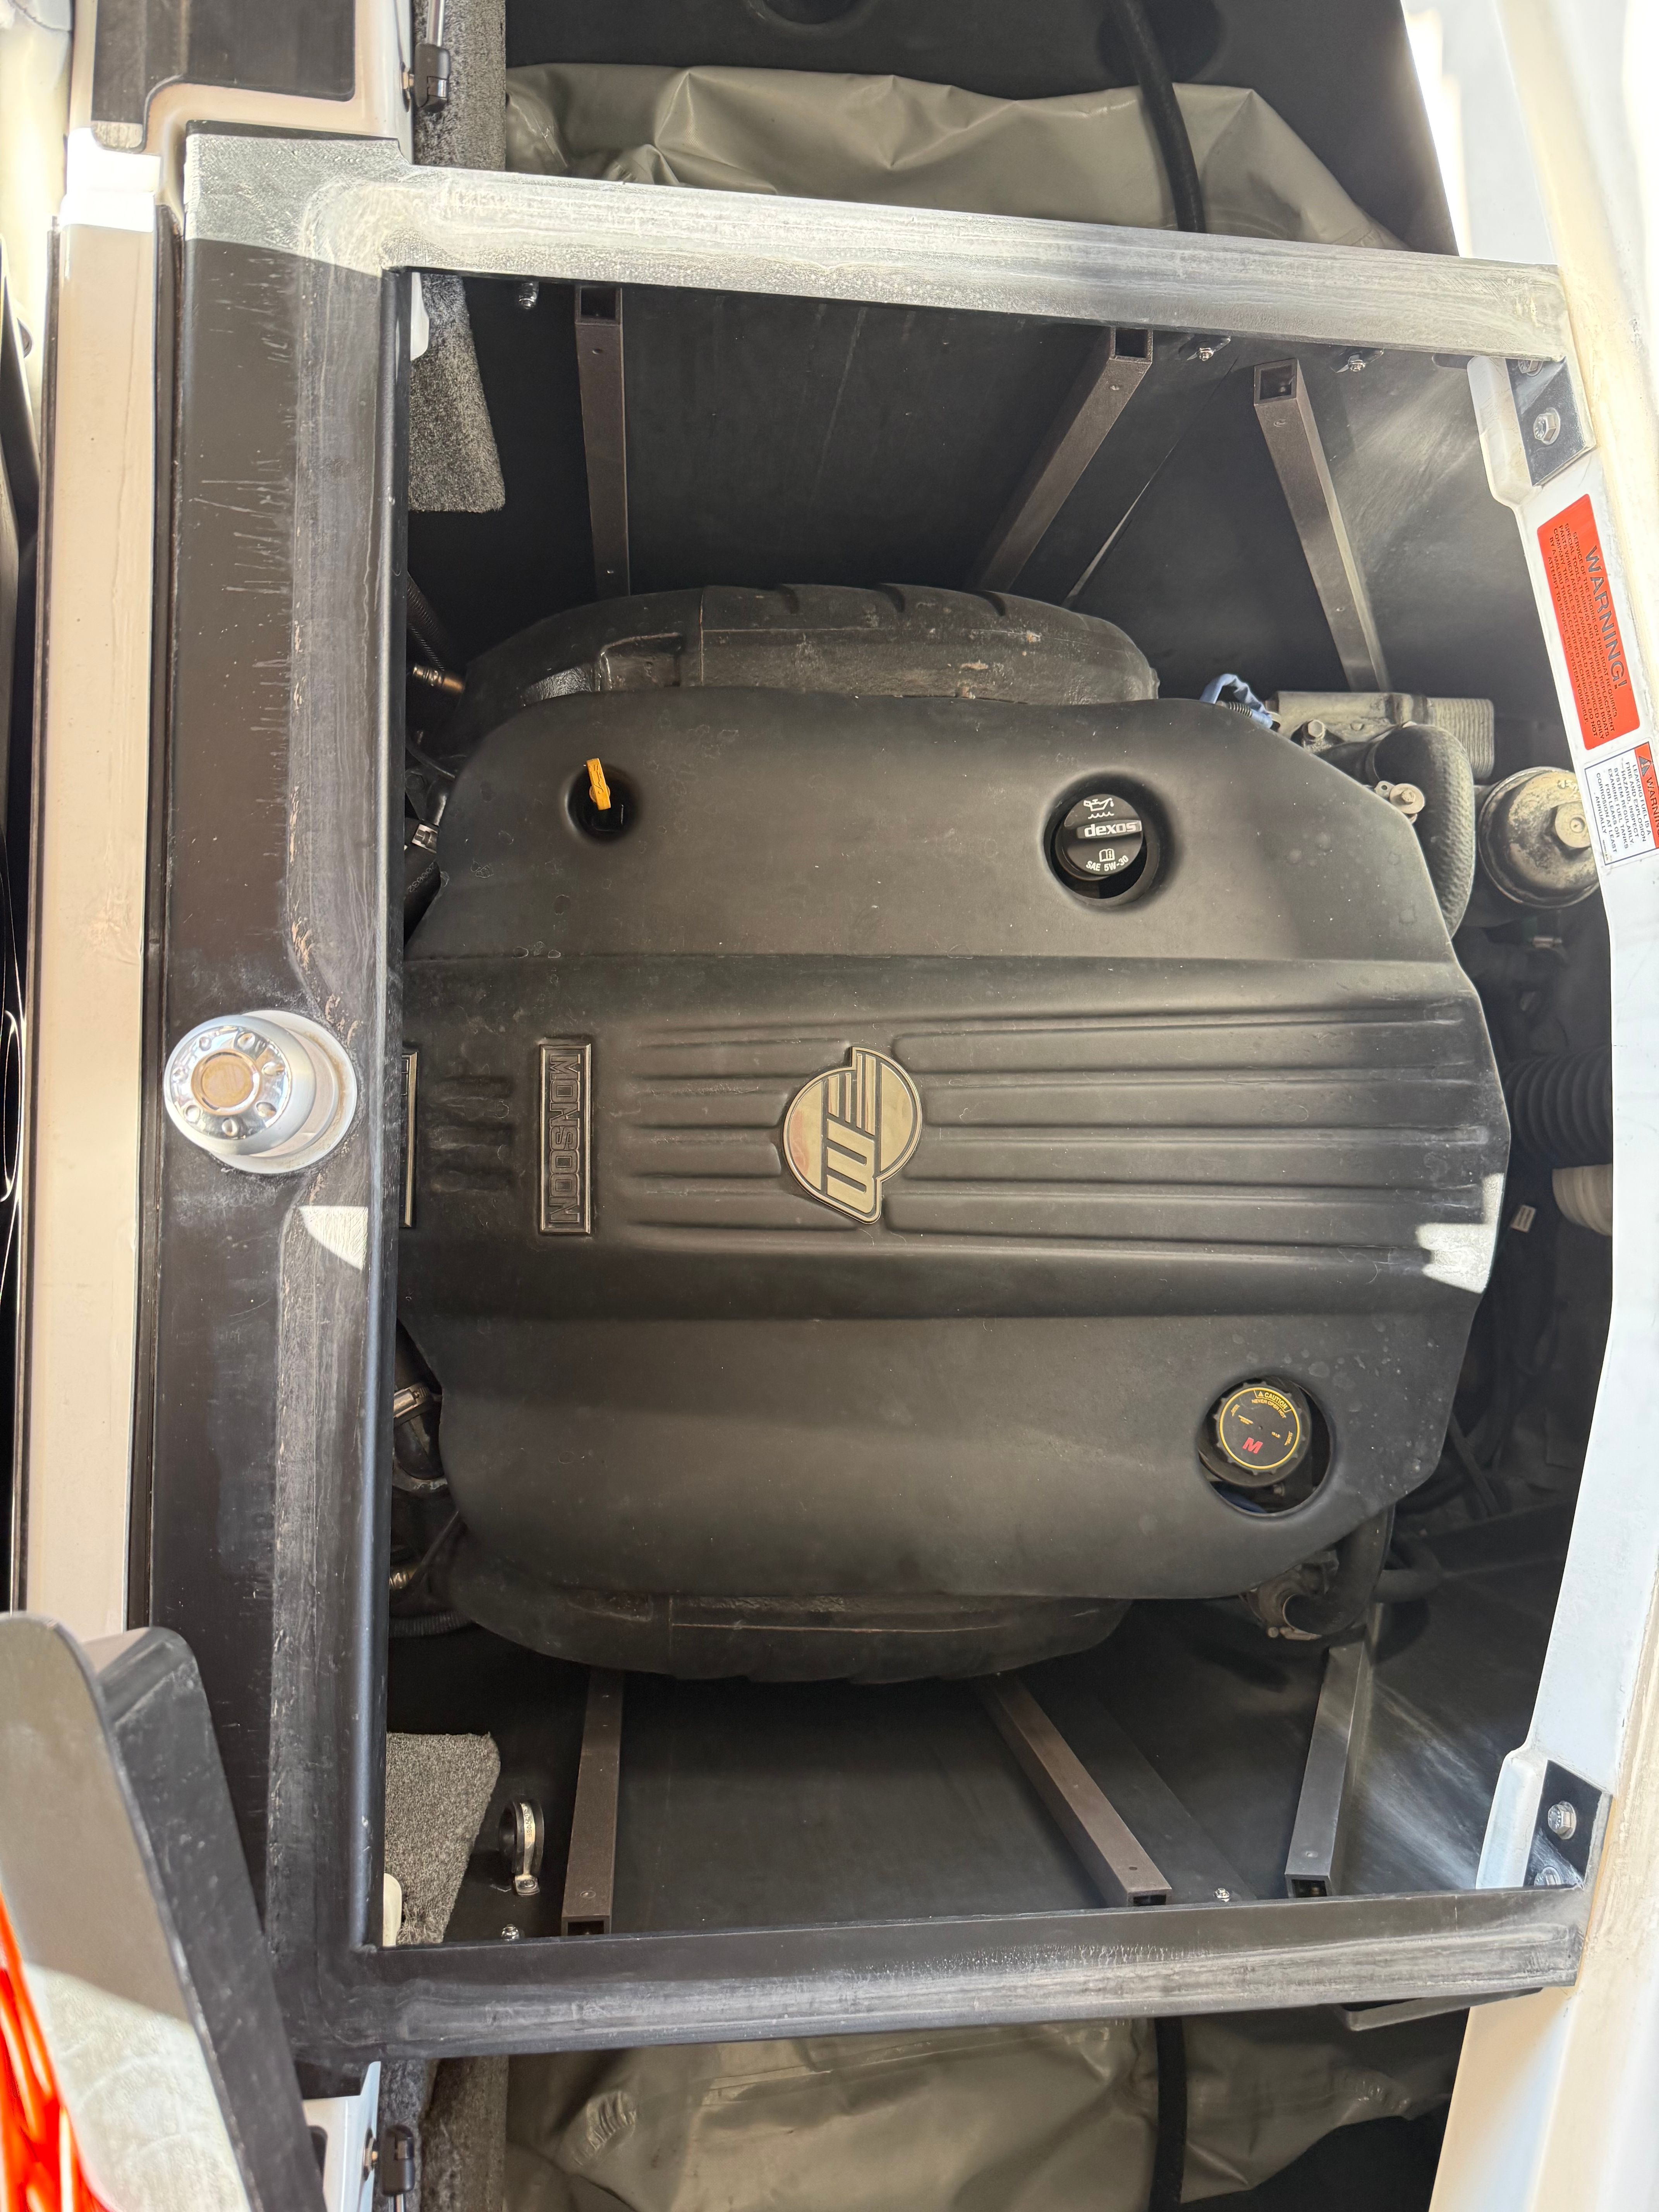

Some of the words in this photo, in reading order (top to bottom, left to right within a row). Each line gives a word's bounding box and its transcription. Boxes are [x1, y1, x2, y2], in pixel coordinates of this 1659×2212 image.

[1548, 557, 1558, 589] ATTEMPT
[1556, 591, 1561, 602] TO
[1559, 603, 1568, 634] SERVICE
[1570, 652, 1579, 682] SYSTEM
[1549, 537, 1554, 546] BY
[1554, 556, 1563, 584] MALIBU
[1561, 585, 1571, 618] TRAINED
[1568, 620, 1580, 658] CERTIFIED
[1588, 708, 1593, 720] DO
[1559, 525, 1567, 550] PARTS
[1565, 550, 1573, 577] WHICH
[1579, 617, 1591, 655] AVAILABLE
[1594, 681, 1603, 710] MALIBU
[1601, 711, 1609, 737] BOATS
[1565, 523, 1575, 555] SPECIAL
[1579, 585, 1589, 622] TRAINING
[1591, 641, 1601, 675] GENUINE
[1599, 676, 1614, 732] REPLACEMENT
[1573, 532, 1583, 564] SERVICE
[1580, 565, 1586, 575] OF
[1587, 594, 1596, 623] ENGINE
[1594, 624, 1599, 636] ON
[1606, 678, 1617, 717] REQUIRES
[1585, 545, 1626, 689] WARNING!
[1571, 605, 1580, 635] SYSTEM
[1578, 637, 1588, 668] SHOULD
[1585, 669, 1590, 680] BE
[1588, 681, 1599, 718] SERVICED
[1614, 768, 1624, 798] SYSTEM
[1632, 764, 1643, 797] LEAKING
[1084, 822, 1137, 837] dexos
[1595, 796, 1607, 833] ANNUALLY
[1596, 773, 1609, 817] CORROSION
[1609, 830, 1617, 852] LEAST
[1608, 768, 1618, 801] EXAMINE
[1620, 824, 1628, 849] TANKS
[1608, 800, 1617, 825] LEAKS
[1614, 826, 1620, 838] OR
[1628, 805, 1639, 837] INSPECT
[1633, 799, 1647, 842] EXPLOSION
[1086, 860, 1101, 871] SAE
[1104, 855, 1129, 871] 5W-30
[550, 1054, 580, 1223] MONSOON
[1264, 1392, 1288, 1409] CAUTION
[1267, 1401, 1279, 1410] OPEN
[1278, 1409, 1286, 1418] HOT
[1243, 1437, 1263, 1453] M
